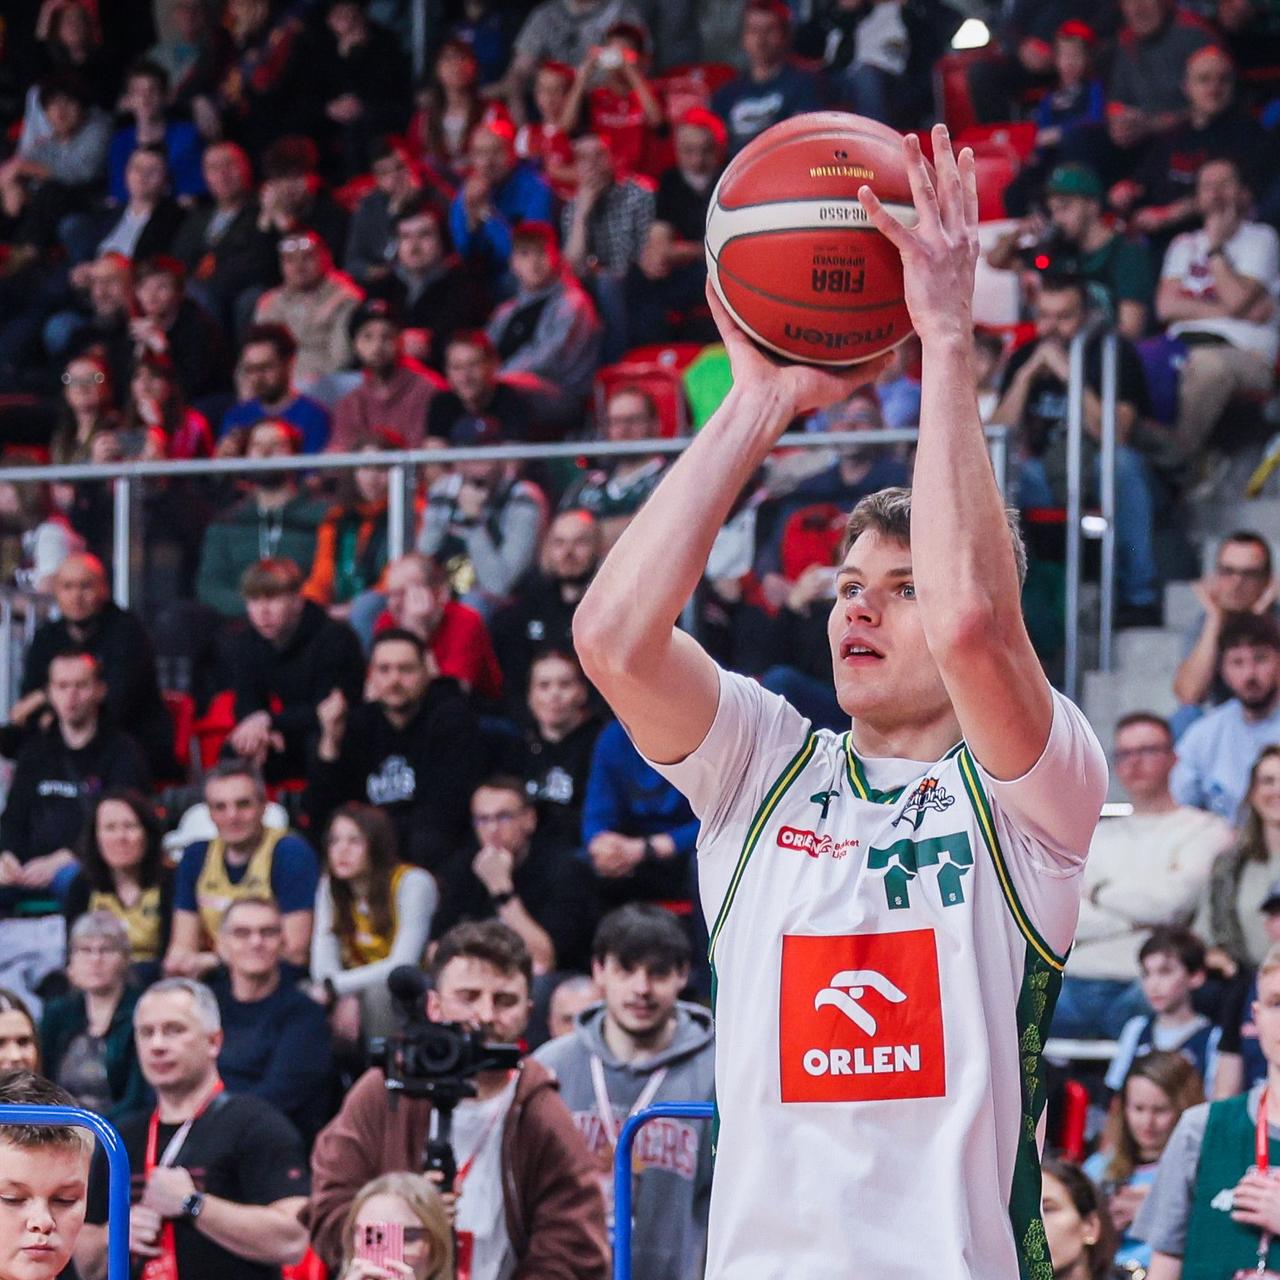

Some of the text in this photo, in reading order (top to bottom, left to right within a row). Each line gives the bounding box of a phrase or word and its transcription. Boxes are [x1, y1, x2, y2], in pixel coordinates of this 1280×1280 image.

[809, 166, 875, 181] COMPETITION
[812, 255, 865, 266] APPROVED
[811, 268, 865, 294] FIBA
[784, 322, 894, 350] molten
[834, 839, 859, 851] Bket
[802, 1044, 920, 1077] ORLEN
